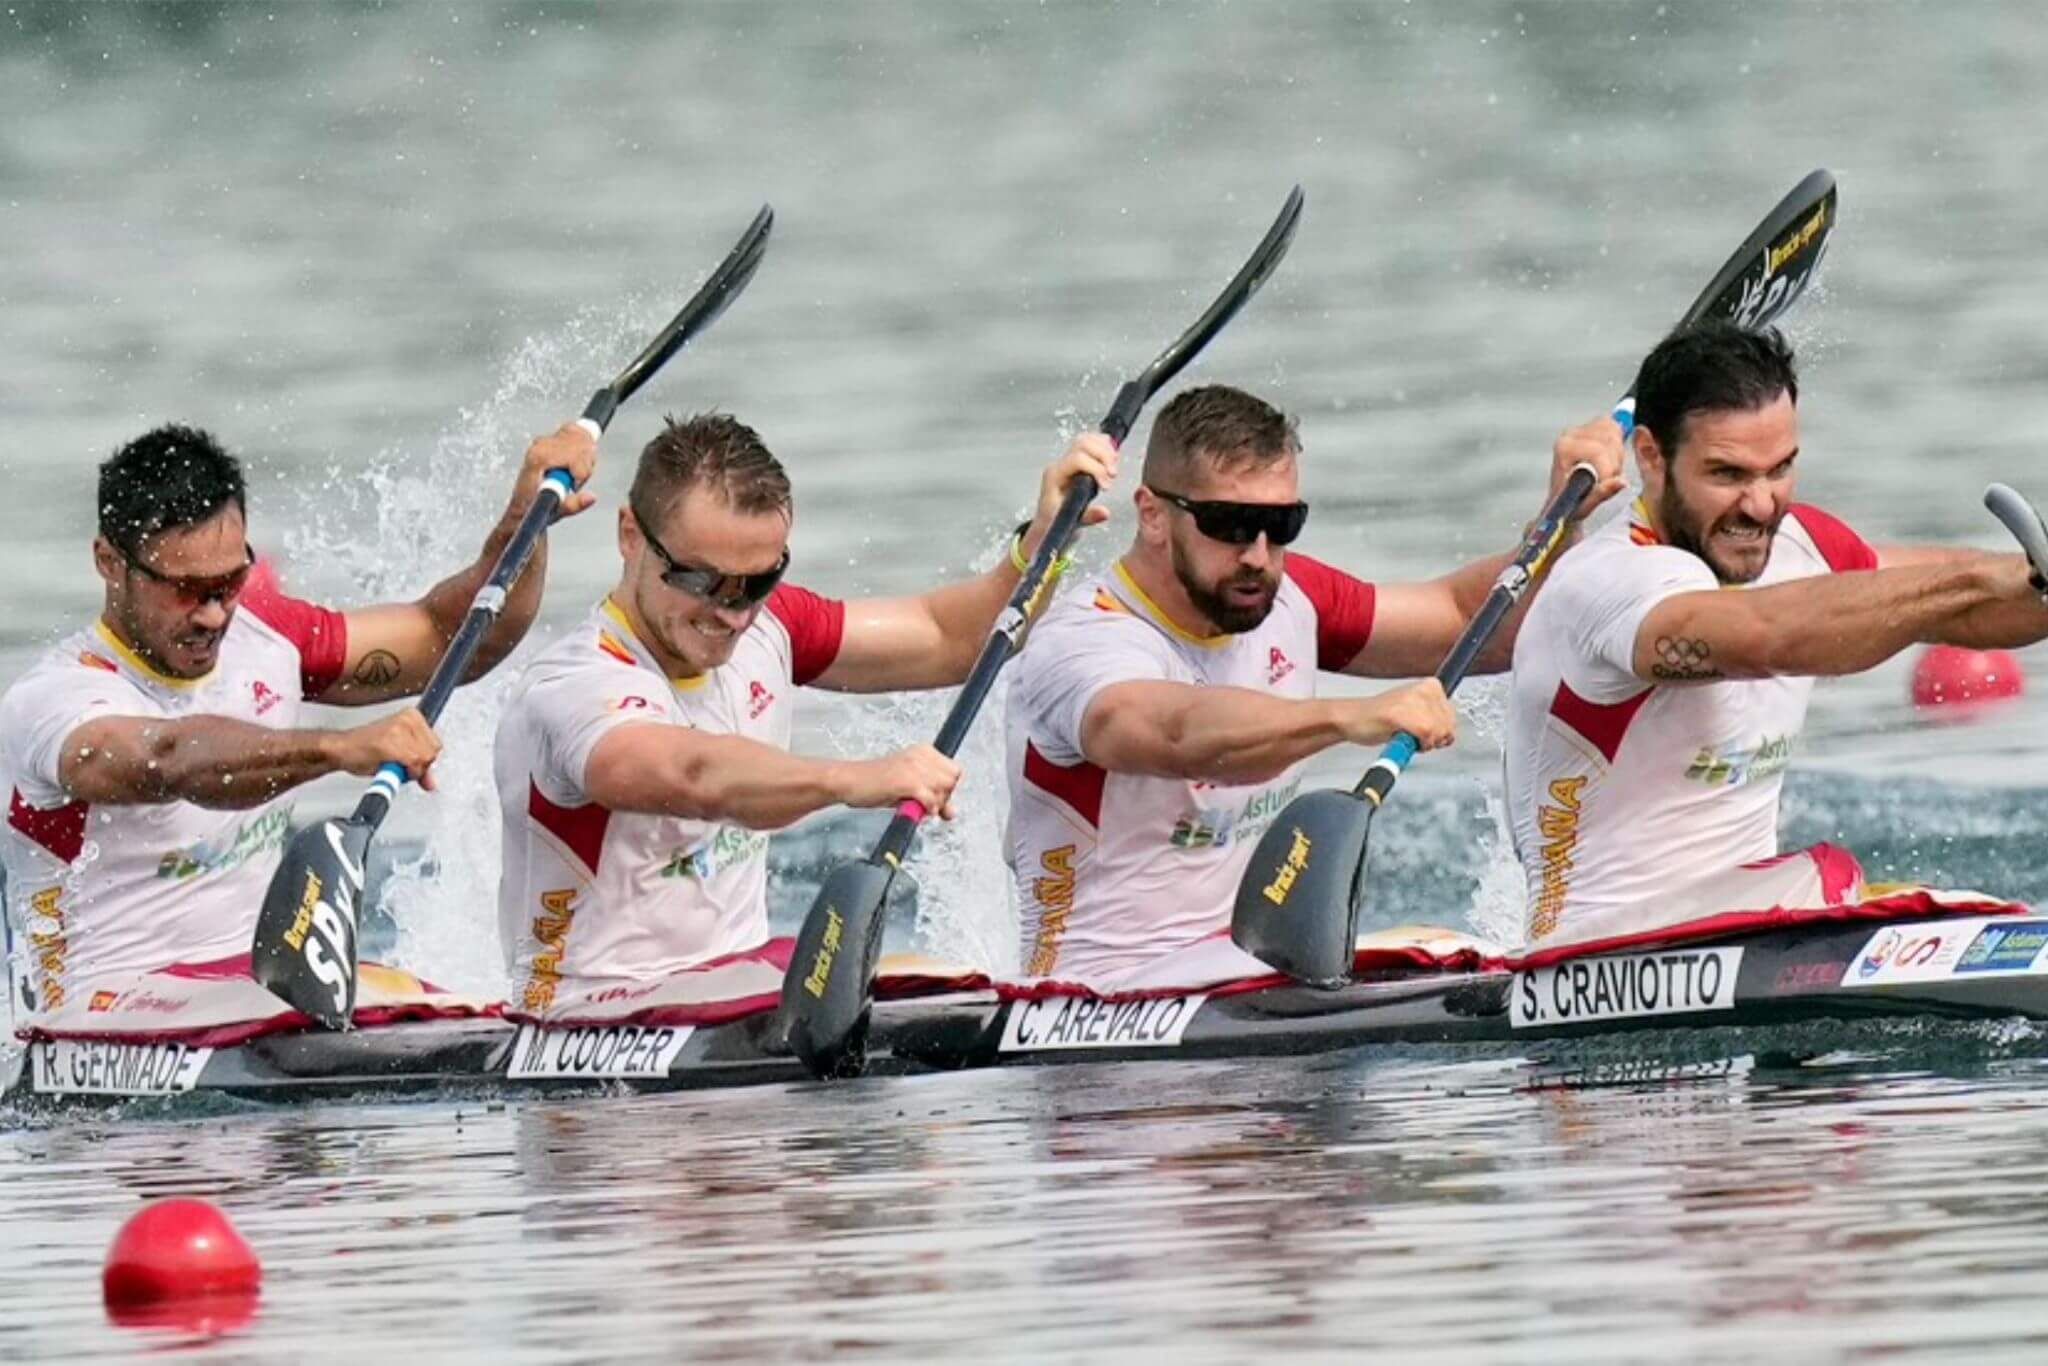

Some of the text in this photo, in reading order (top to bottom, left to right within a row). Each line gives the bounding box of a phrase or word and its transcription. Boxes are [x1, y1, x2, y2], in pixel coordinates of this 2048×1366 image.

[1522, 969, 1546, 1021] S.
[1553, 952, 1723, 1018] CRAVIOTTO
[1016, 998, 1188, 1046] C. AREVALO
[42, 1043, 198, 1090] R. GERMADE
[520, 1025, 675, 1073] M. COOPER
